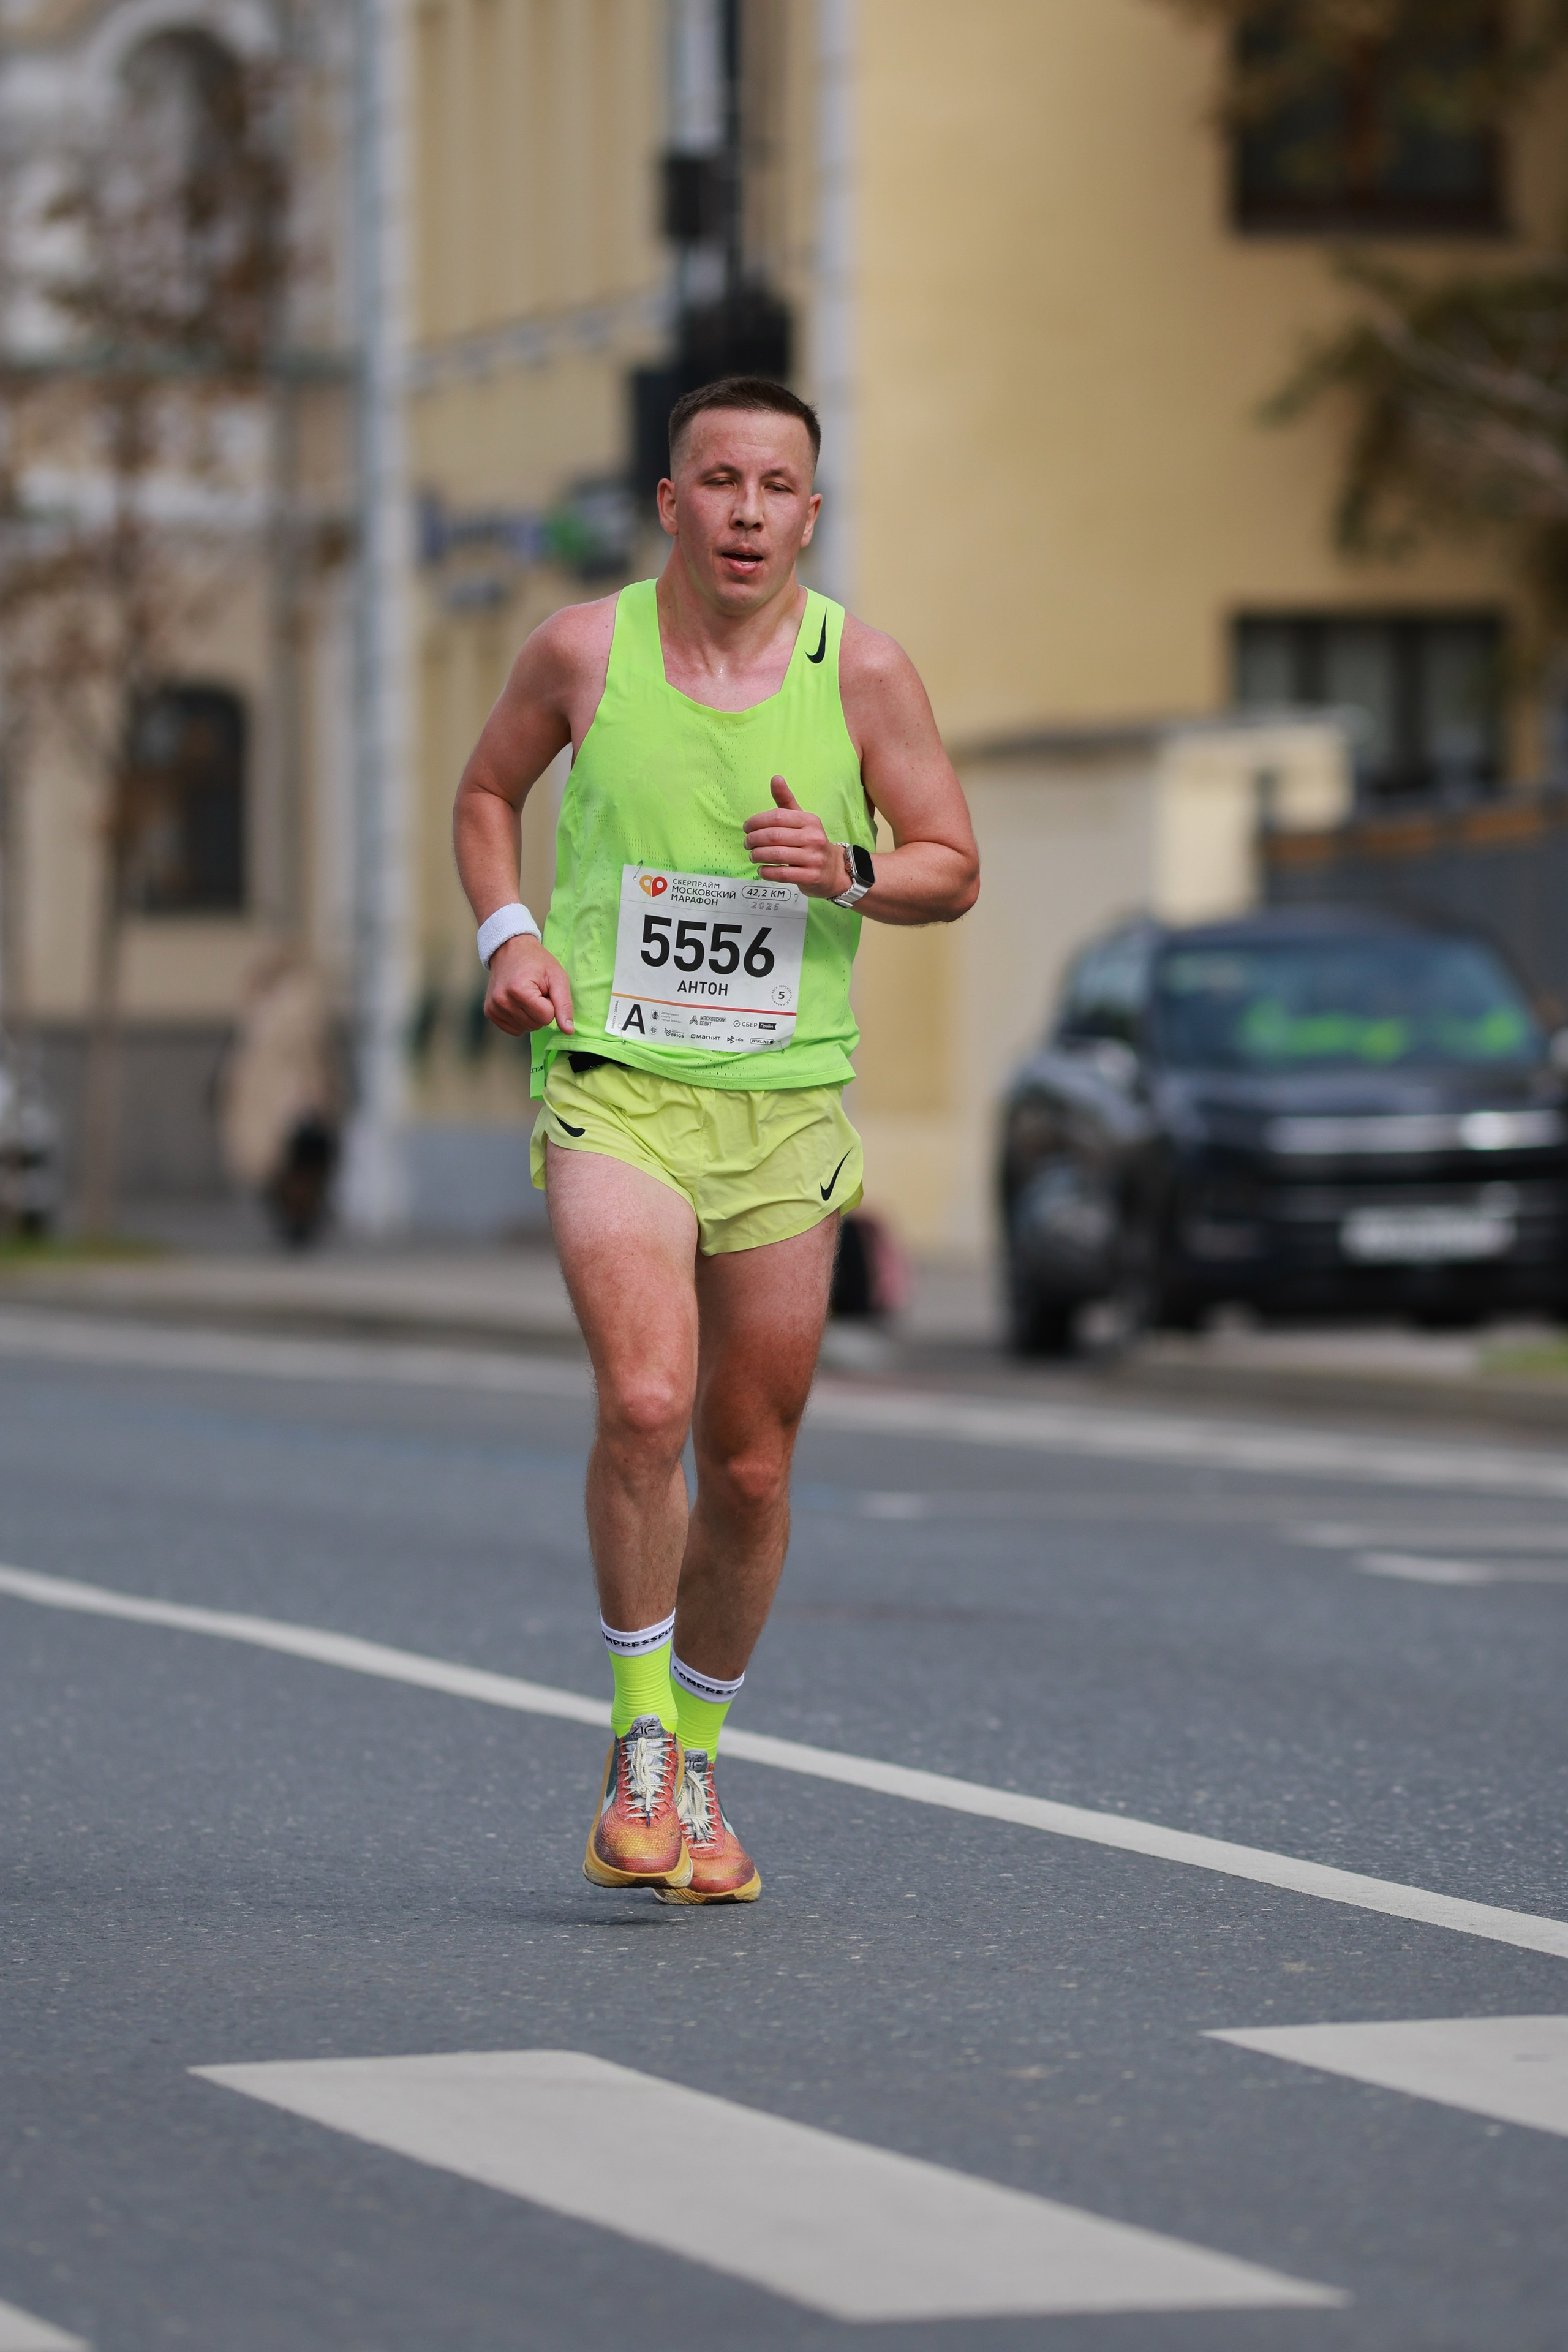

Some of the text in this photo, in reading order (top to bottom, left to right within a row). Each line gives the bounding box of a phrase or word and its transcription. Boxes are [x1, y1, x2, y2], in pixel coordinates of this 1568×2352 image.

[673, 878, 720, 889] СБЕРПРАЙМ
[671, 886, 736, 899] МОСКОВСКИЙ
[747, 888, 785, 899] 42,2 КМ
[671, 894, 718, 906] МАРАФОН
[751, 902, 780, 911] 2026
[640, 914, 775, 978] 5556
[677, 980, 728, 996] АНТОН
[778, 991, 785, 1000] 5
